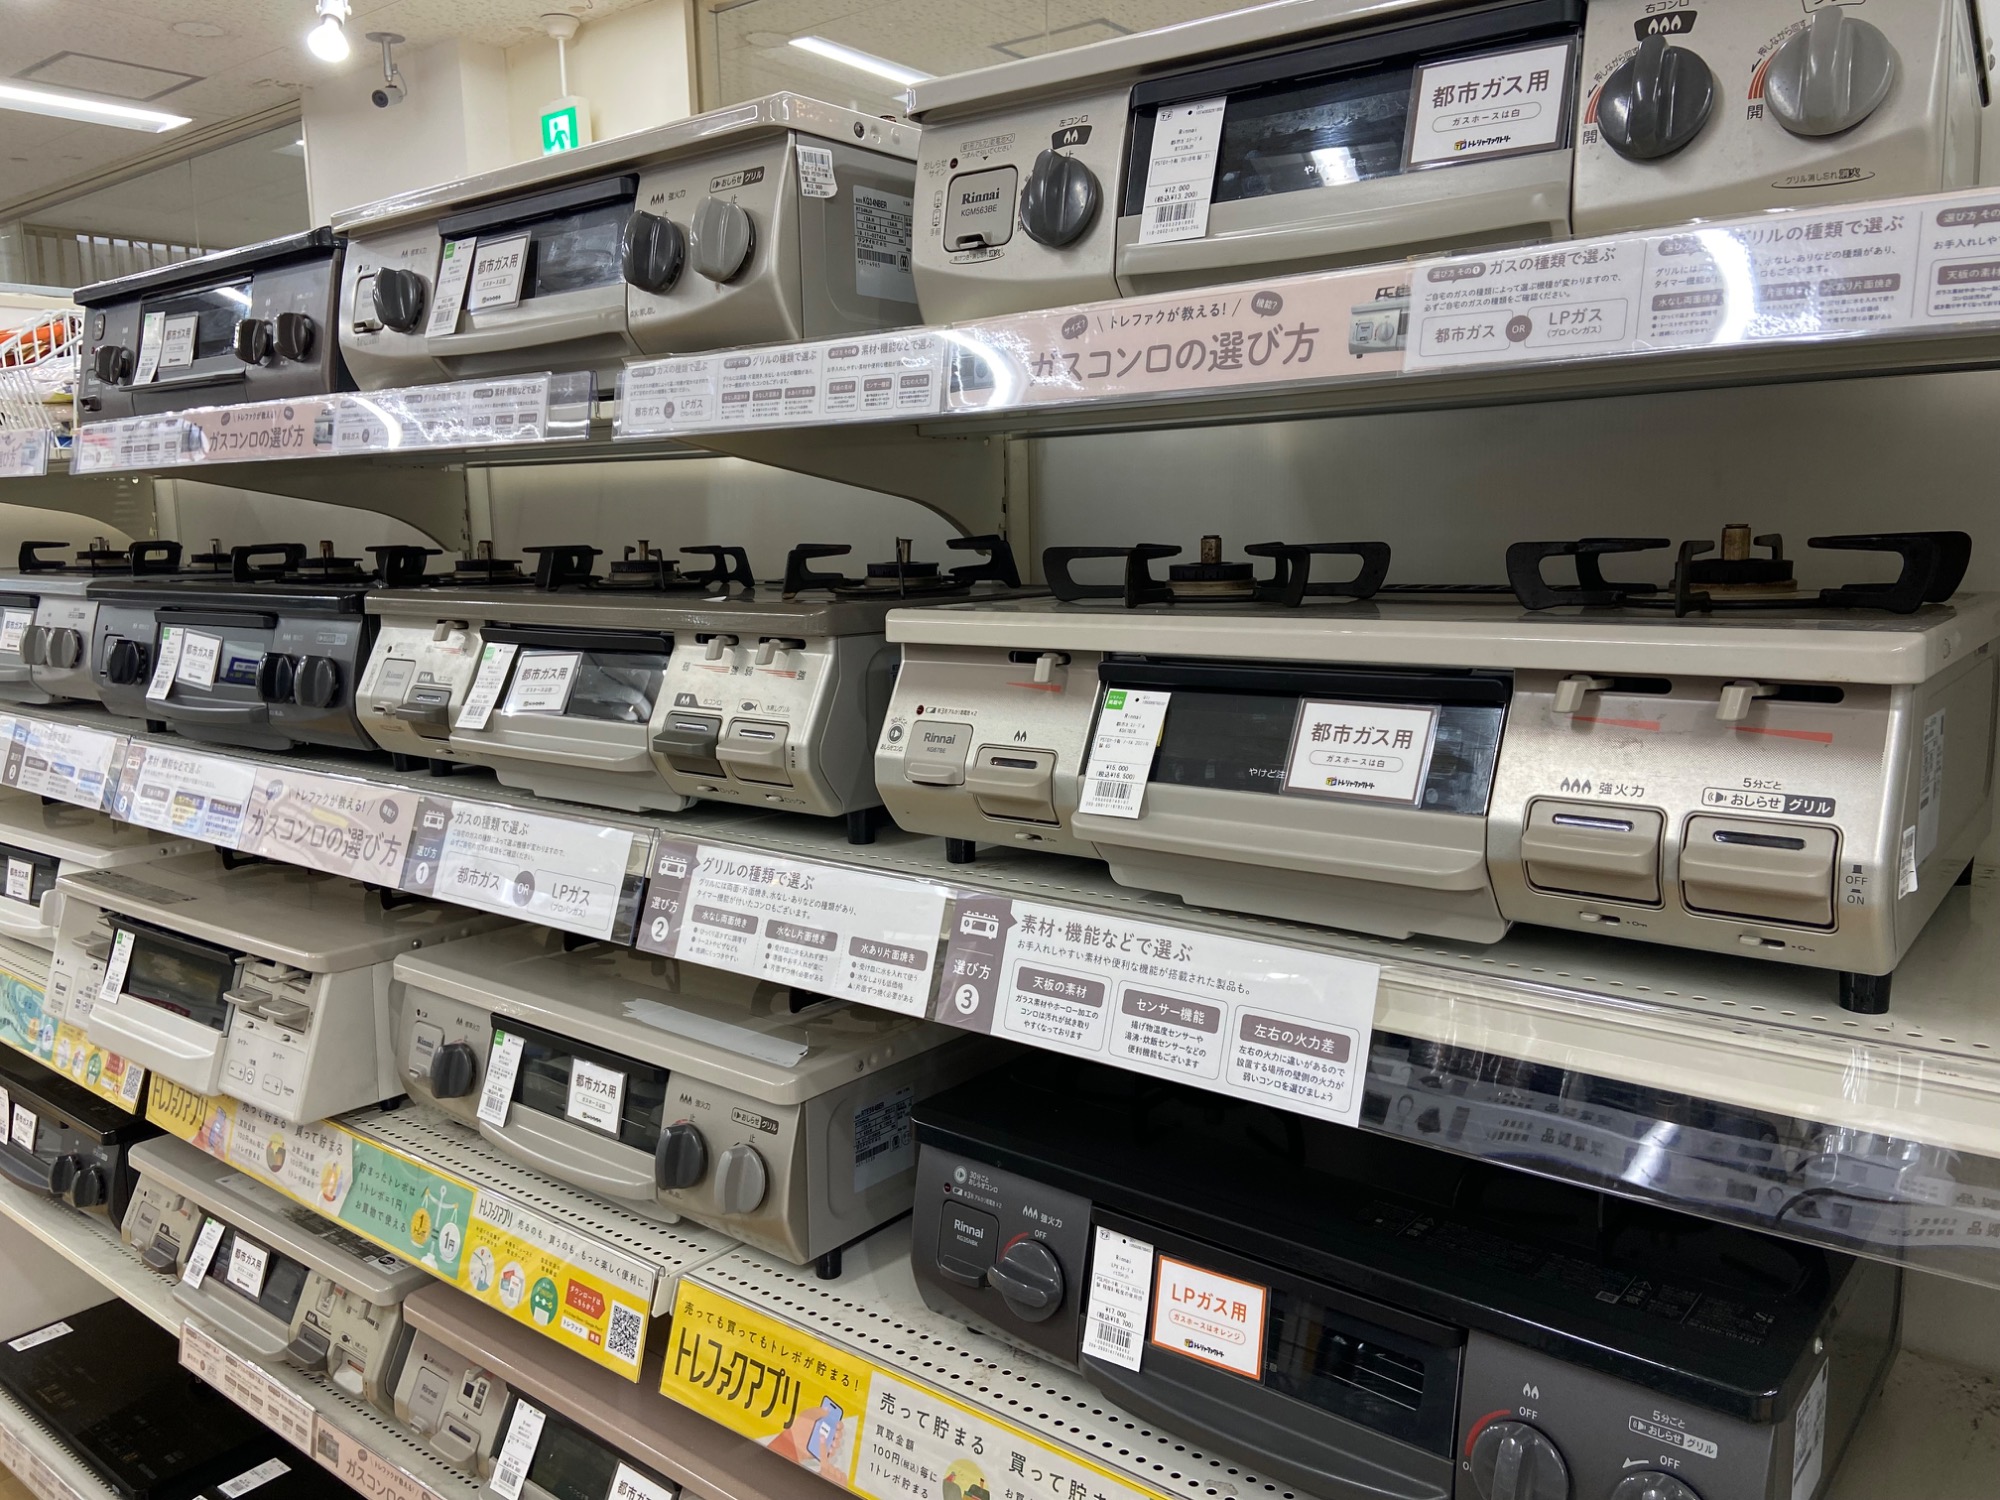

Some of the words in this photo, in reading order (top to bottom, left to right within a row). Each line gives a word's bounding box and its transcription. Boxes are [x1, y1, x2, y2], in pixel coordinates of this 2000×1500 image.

[1431, 69, 1550, 110] 都市ガス用
[1451, 107, 1521, 128] ガスホースは白
[1747, 104, 1764, 121] 開
[1582, 130, 1598, 145] 開
[961, 187, 1000, 205] Rinnai
[477, 253, 519, 275] 都市ガス用
[1489, 247, 1616, 277] ガスの種類で選ぶ
[1549, 306, 1603, 326] LPガス
[1435, 324, 1496, 345] 都市ガス
[1511, 323, 1526, 335] OR
[751, 350, 818, 367] グリルの種類で選ぶ
[1031, 321, 1321, 387] ガスコンロの選び方
[209, 424, 306, 452] ガスコンロの選び方
[521, 666, 569, 682] 都市ガス用
[923, 732, 957, 745] Rinnai
[1310, 721, 1414, 750] 都市ガス用
[1325, 754, 1387, 769] ガスホースは白
[1598, 780, 1645, 798] 強火力
[1742, 776, 1783, 791] 5分ごと
[454, 811, 530, 836] ガスの種類で選ぶ
[248, 808, 402, 868] ガスコンロの選び方
[416, 845, 437, 859] 選び方
[457, 866, 500, 891] 都市ガス
[701, 856, 816, 892] グリルの種類で選ぶ
[1845, 874, 1869, 885] OFF
[517, 882, 531, 896] OR
[552, 882, 591, 907] LPガス
[1845, 893, 1866, 905] ON
[650, 895, 680, 915] 選び方
[701, 910, 749, 929] 水なし両面焼き
[775, 925, 827, 946] 水なし片面焼き
[1020, 913, 1193, 963] 素材・機能などで選ぶ
[859, 943, 917, 964] 水あり片面焼き
[952, 958, 992, 981] 選び方
[1017, 939, 1251, 995] お手入れしやすい素材や便利な機能が搭載された製品も。
[1032, 975, 1088, 999] 天板の素材
[1015, 994, 1099, 1020] ガラス素材やホーロー加工の
[1020, 1007, 1090, 1031] コンロは汚れが拭き取り
[1136, 998, 1206, 1026] センサー機能
[1023, 1020, 1083, 1041] やすくなっております
[1130, 1019, 1205, 1044] 揚げ物温度センサーや
[1253, 1023, 1336, 1055] 左右の火力差
[1127, 1044, 1200, 1069] 便利機能もございます
[1238, 1044, 1346, 1078] 左右の火力に違いがあるので
[1236, 1057, 1345, 1091] 設置する場所の壁側の火力が
[576, 1073, 618, 1100] 都市ガス用
[1242, 1072, 1334, 1103] 弱いコンロを選びましょう
[295, 1124, 344, 1157] 買って貯まる
[360, 1161, 417, 1197] 貯まったトレポは
[969, 1170, 990, 1184] 30分ごと
[355, 1200, 407, 1234] お買物で使える
[478, 1198, 514, 1228] トレファクアプリ
[1040, 1212, 1064, 1229] 強火力
[953, 1218, 985, 1239] Rinnai
[1034, 1228, 1048, 1241] OFF
[234, 1247, 263, 1272] 都市ガス用
[569, 1285, 602, 1307] ダウンロードは
[573, 1297, 596, 1313] こちらから
[1171, 1283, 1248, 1324] LPガス用
[562, 1319, 584, 1335] トレファク
[1173, 1312, 1242, 1342] ガスホースはオレンジ
[684, 1300, 860, 1392] 売っても買ってもトレポが貯まる!
[674, 1326, 802, 1430] トレファクアプリ
[880, 1391, 985, 1456] 売って貯まる
[1518, 1406, 1539, 1420] OFF
[1652, 1409, 1687, 1430] 5分ごと
[875, 1423, 916, 1453] 買取金額
[1659, 1455, 1682, 1470] OFF
[869, 1462, 929, 1500] 1トレポ貯まる
